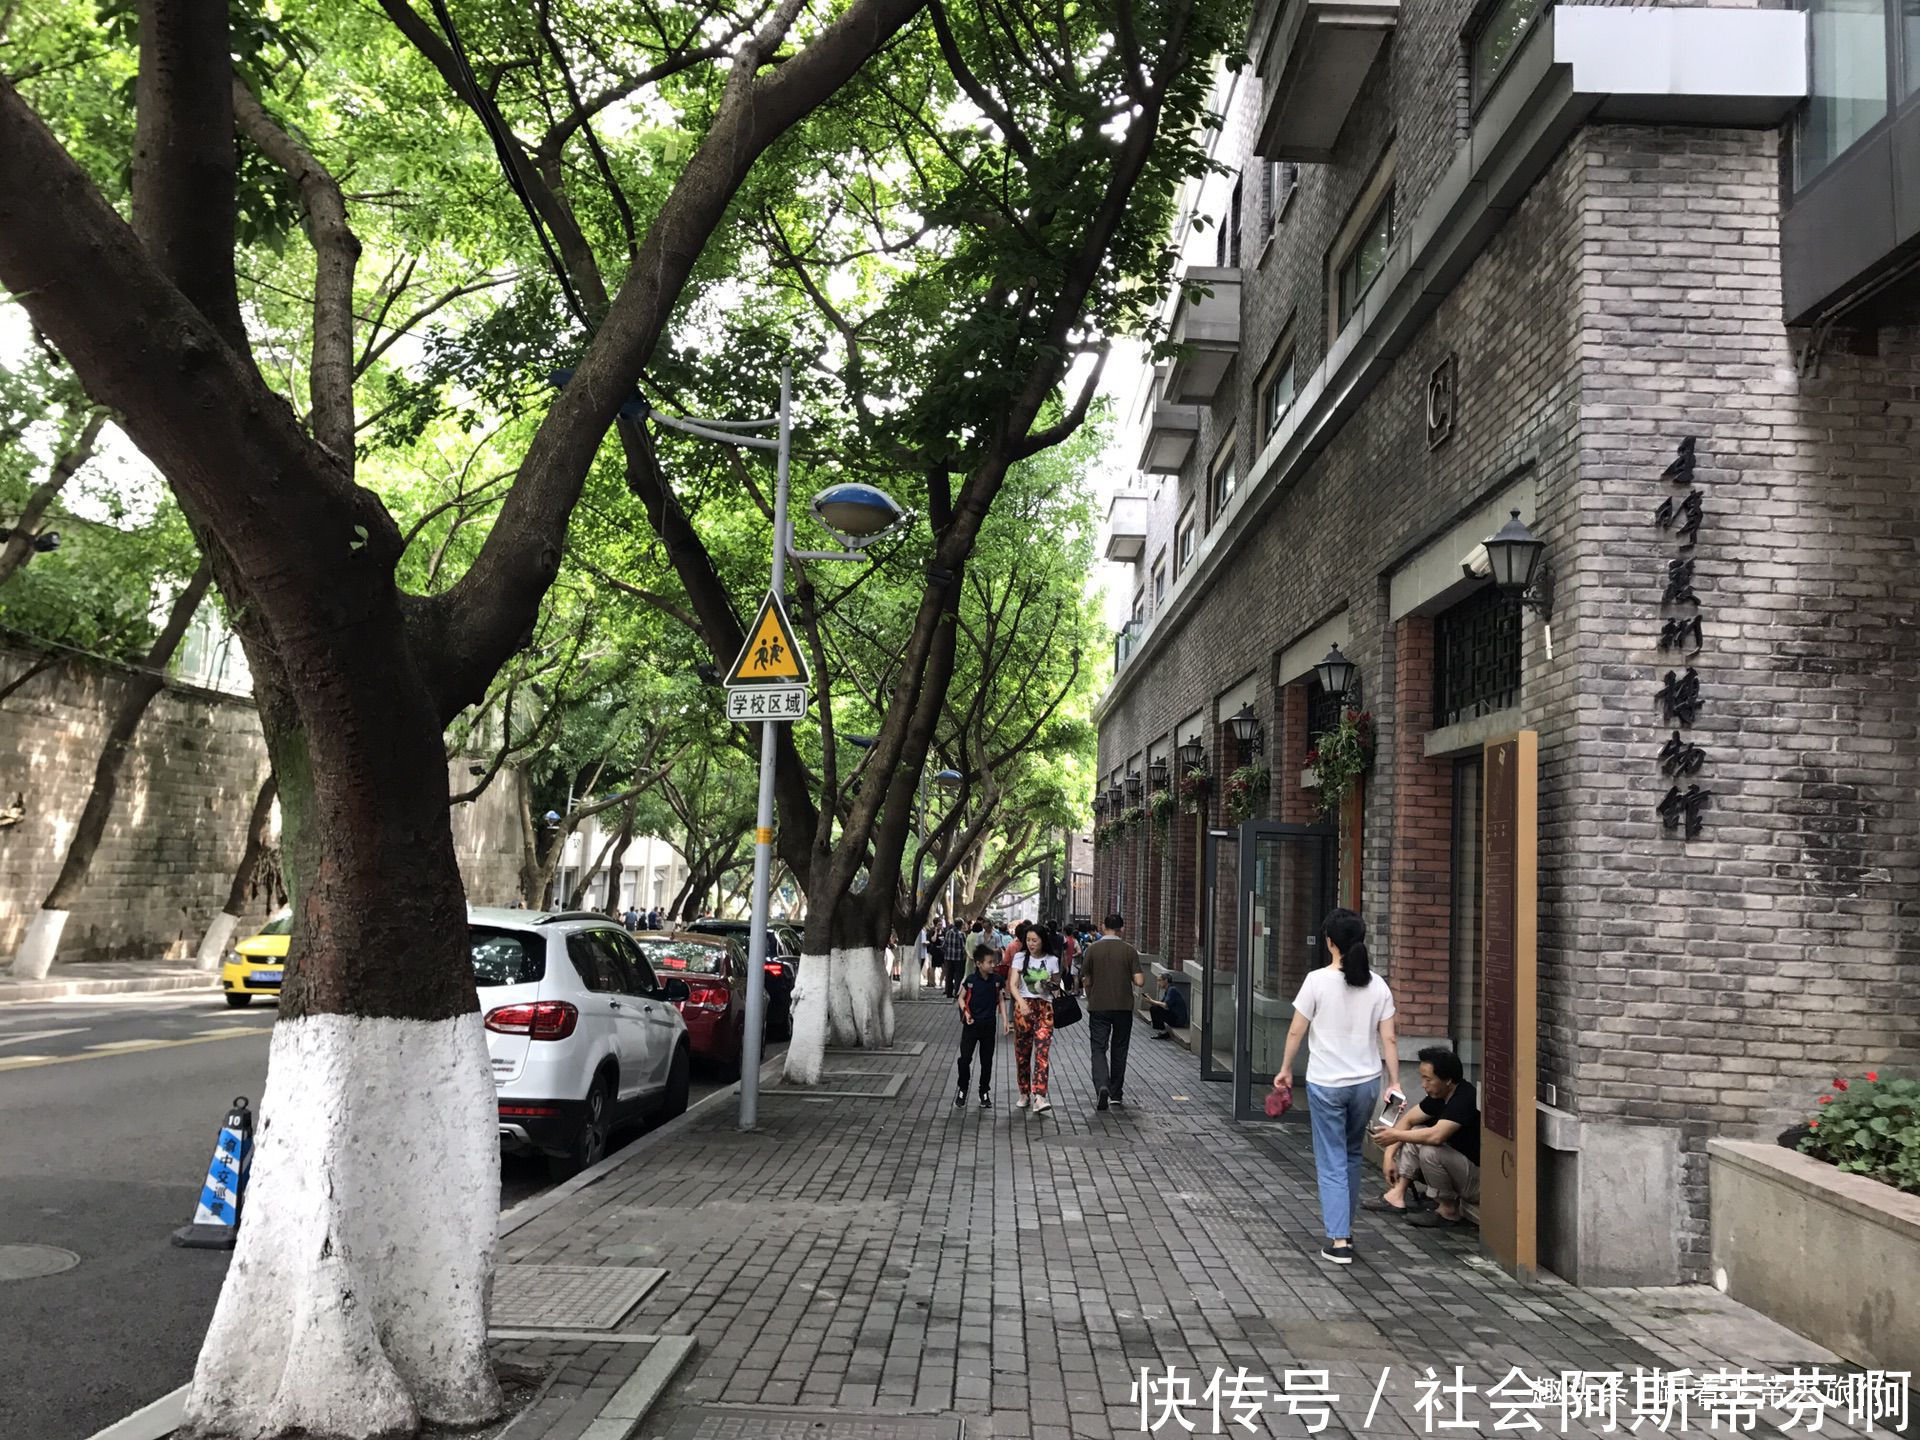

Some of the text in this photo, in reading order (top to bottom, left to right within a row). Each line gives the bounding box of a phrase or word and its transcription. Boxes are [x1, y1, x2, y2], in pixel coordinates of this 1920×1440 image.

[733, 693, 801, 715] 学校区域
[228, 1115, 241, 1127] 10
[210, 1137, 237, 1217] 渝中交巡警
